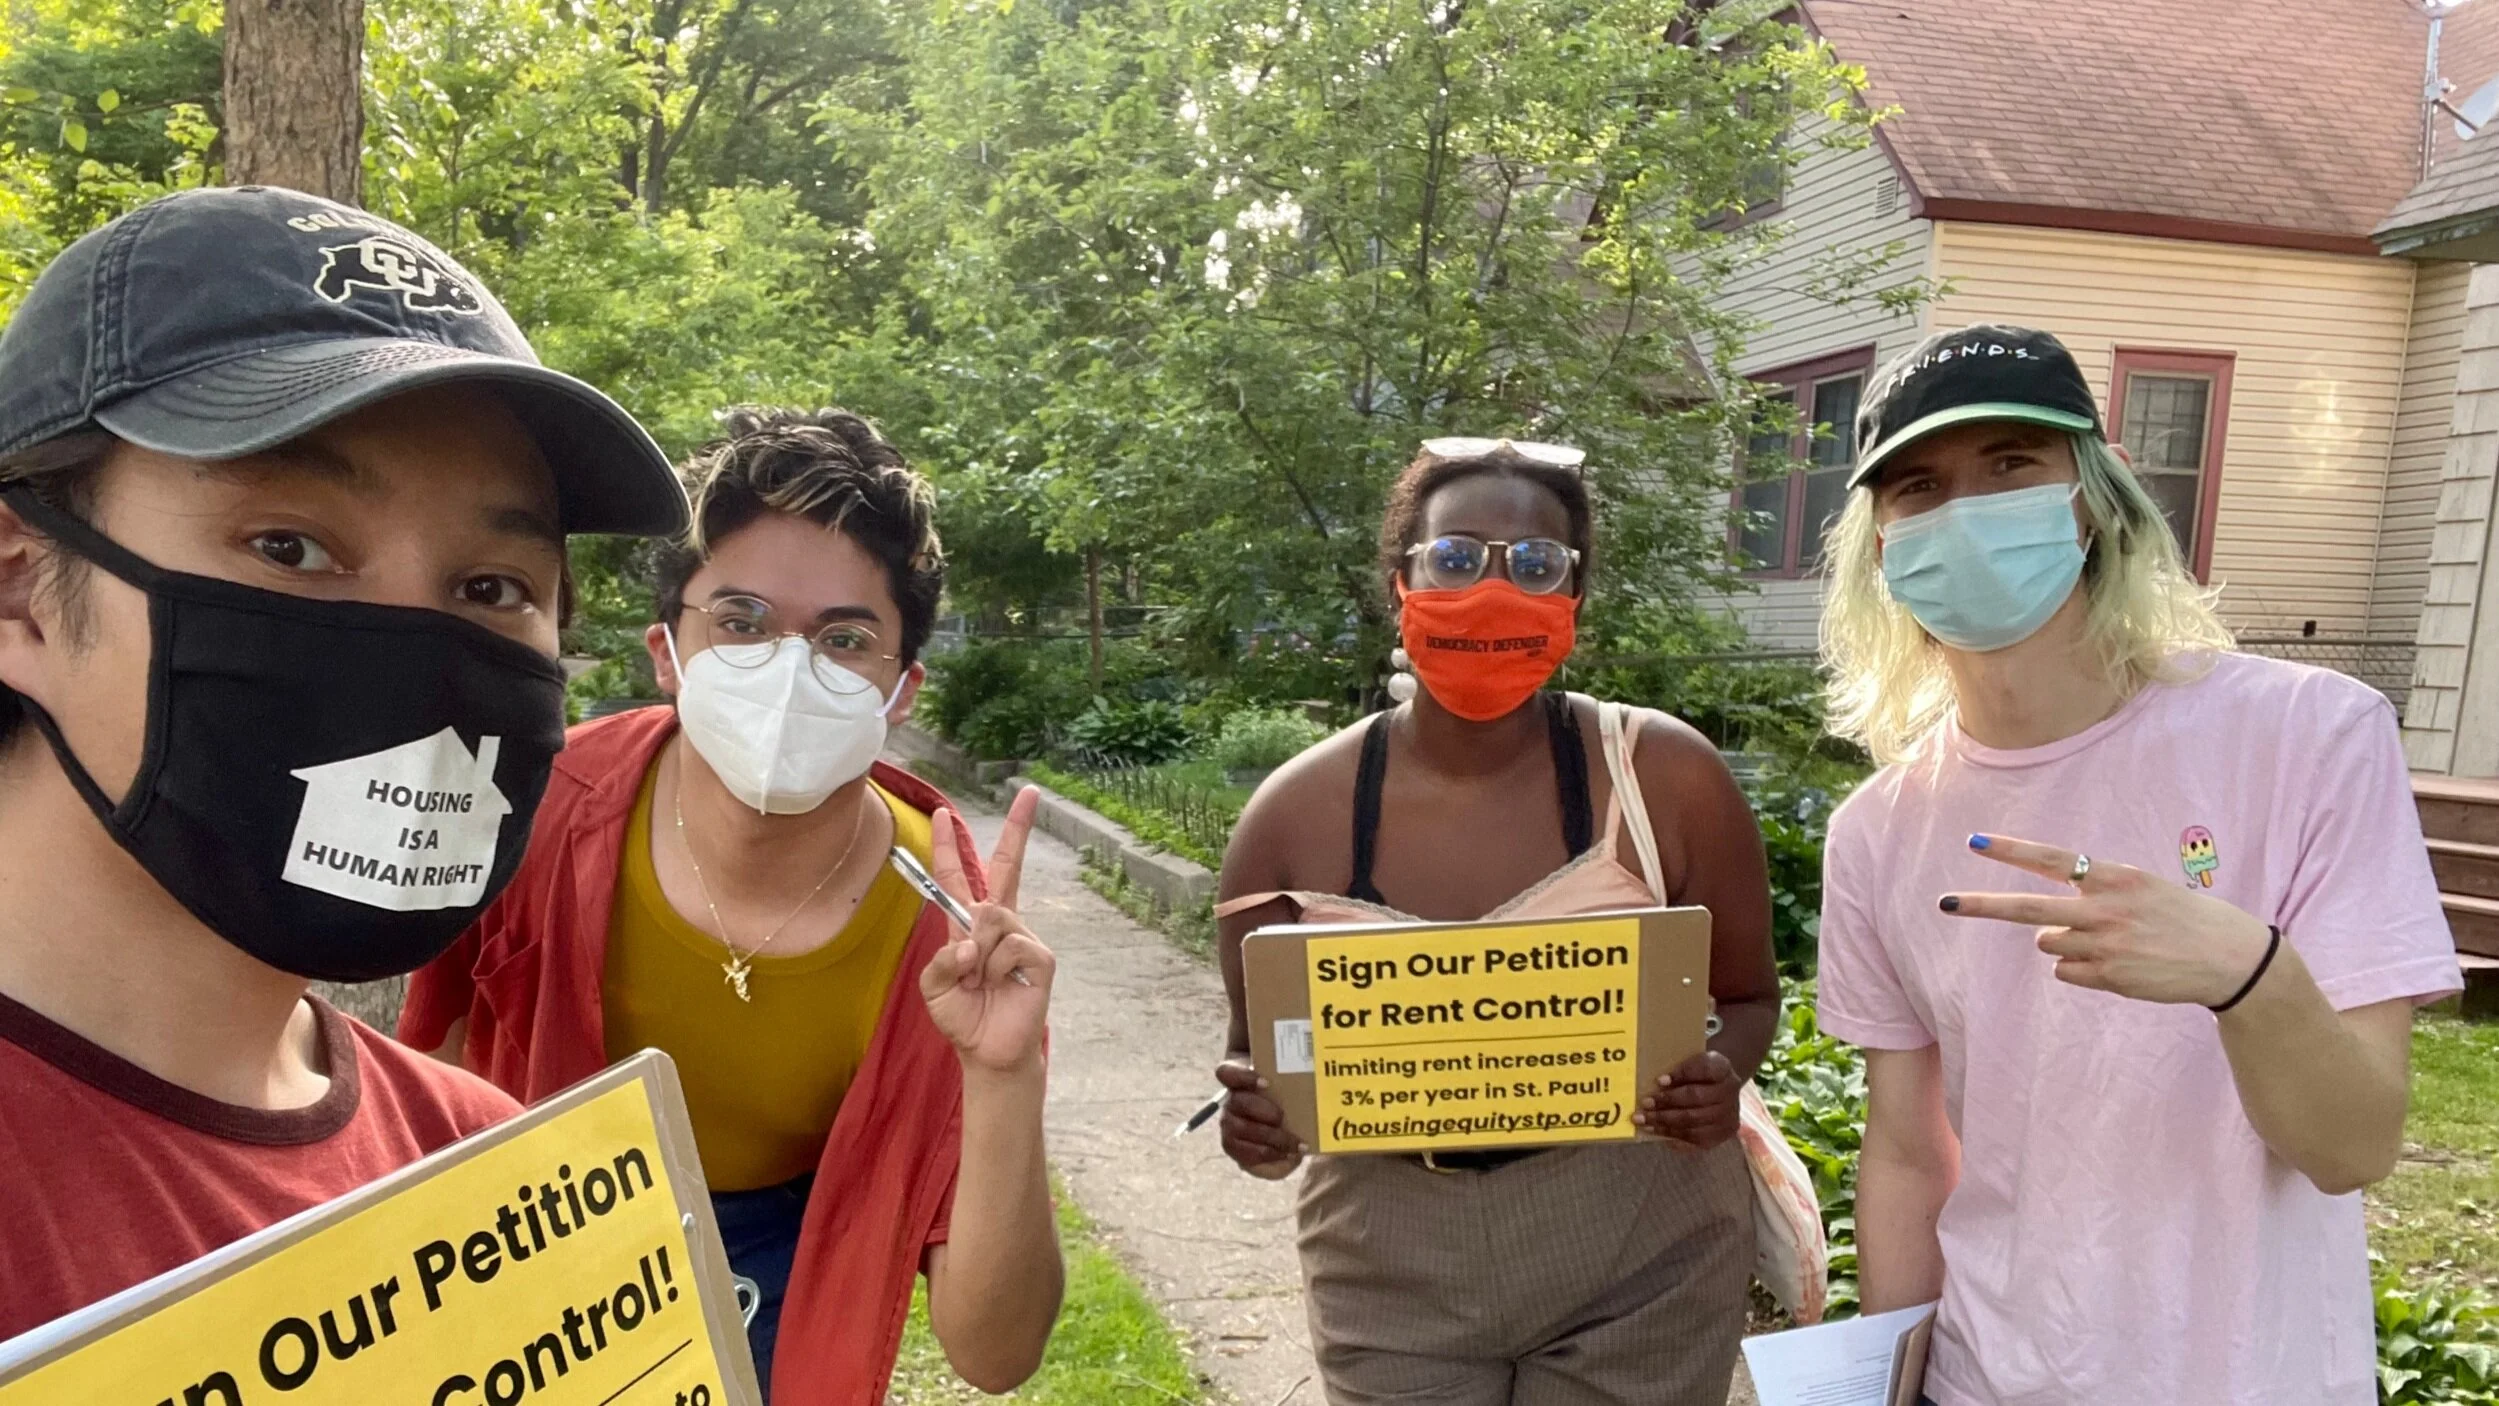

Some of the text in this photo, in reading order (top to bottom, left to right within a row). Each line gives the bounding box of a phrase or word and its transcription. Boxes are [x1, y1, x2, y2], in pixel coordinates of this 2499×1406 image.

[1426, 635, 1549, 652] DEMOCRACY DEFENDER
[366, 779, 472, 813] HOUSING
[398, 828, 439, 850] IS A
[303, 841, 483, 887] HUMAN RIGHT
[1317, 941, 1628, 989] Sign Our Petition
[1321, 989, 1624, 1029] for Rent Control!
[1324, 1047, 1626, 1078] limiting rent increases to
[1341, 1077, 1609, 1109] 3% per year in St. Paul!
[1332, 1102, 1621, 1141] (housingequitystp.org)
[259, 1148, 654, 1391] Our Petition
